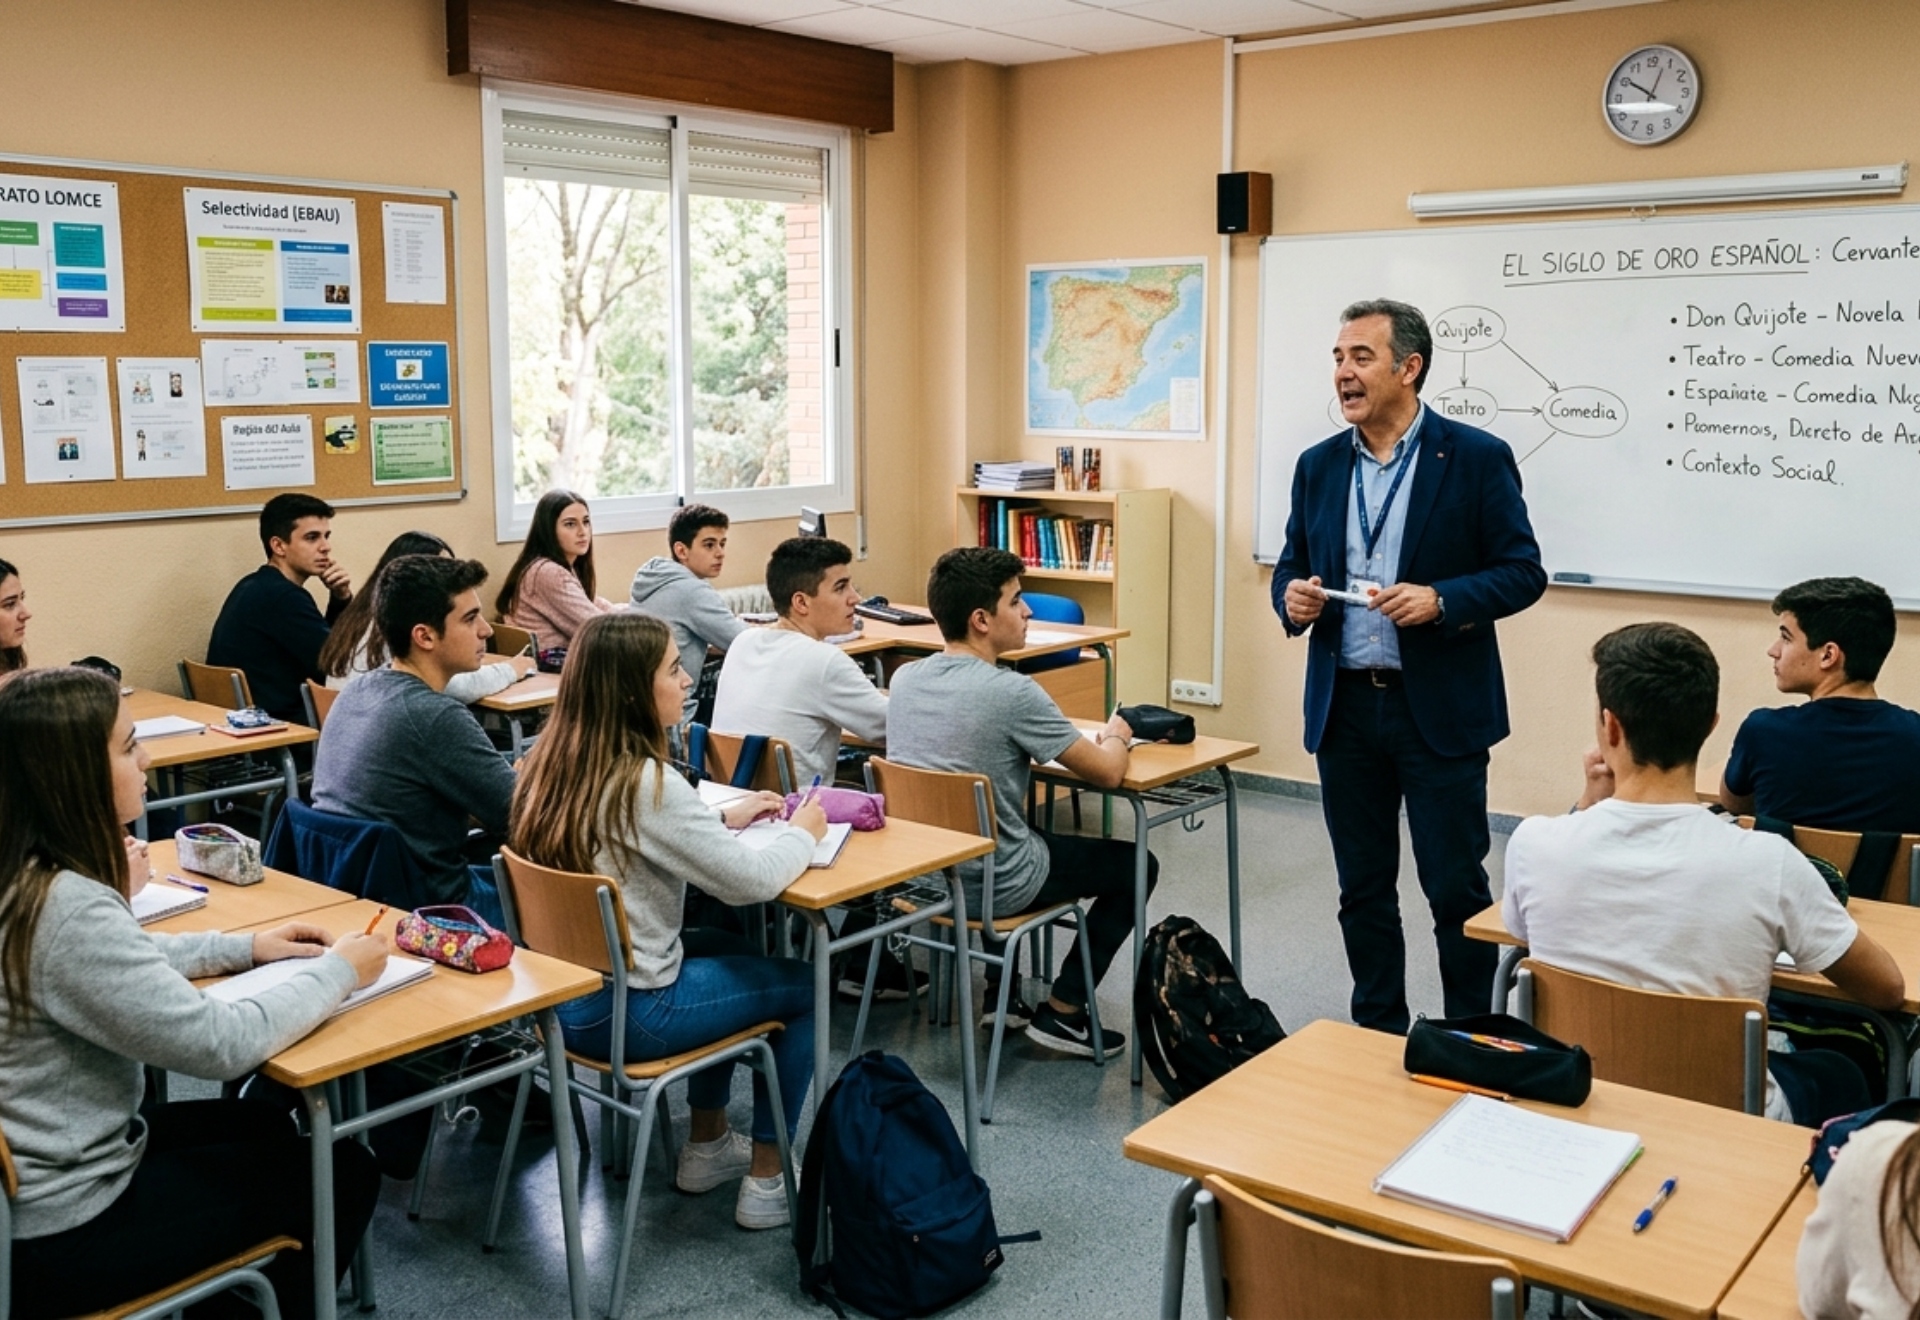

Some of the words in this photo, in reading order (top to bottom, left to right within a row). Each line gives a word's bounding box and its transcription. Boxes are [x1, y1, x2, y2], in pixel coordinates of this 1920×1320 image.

[45, 190, 102, 208] LOMCE
[201, 200, 289, 219] Selectividad
[292, 205, 341, 225] (EBAU)
[1502, 254, 1529, 277] EL
[1542, 251, 1605, 274] SIGLO
[1617, 249, 1644, 272] DE
[1654, 247, 1699, 270] ORO
[1686, 304, 1725, 327] Don
[1735, 302, 1807, 335] Quijote
[1837, 300, 1904, 323] Novela
[1436, 318, 1493, 344] Quijote
[1683, 345, 1746, 366] Teatro
[1771, 344, 1854, 367] Comedia
[1867, 344, 1920, 366] Nuev
[1794, 381, 1878, 404] Comedia
[1549, 398, 1617, 420] Comedia
[1862, 423, 1883, 443] de
[1682, 449, 1761, 476] Contexto
